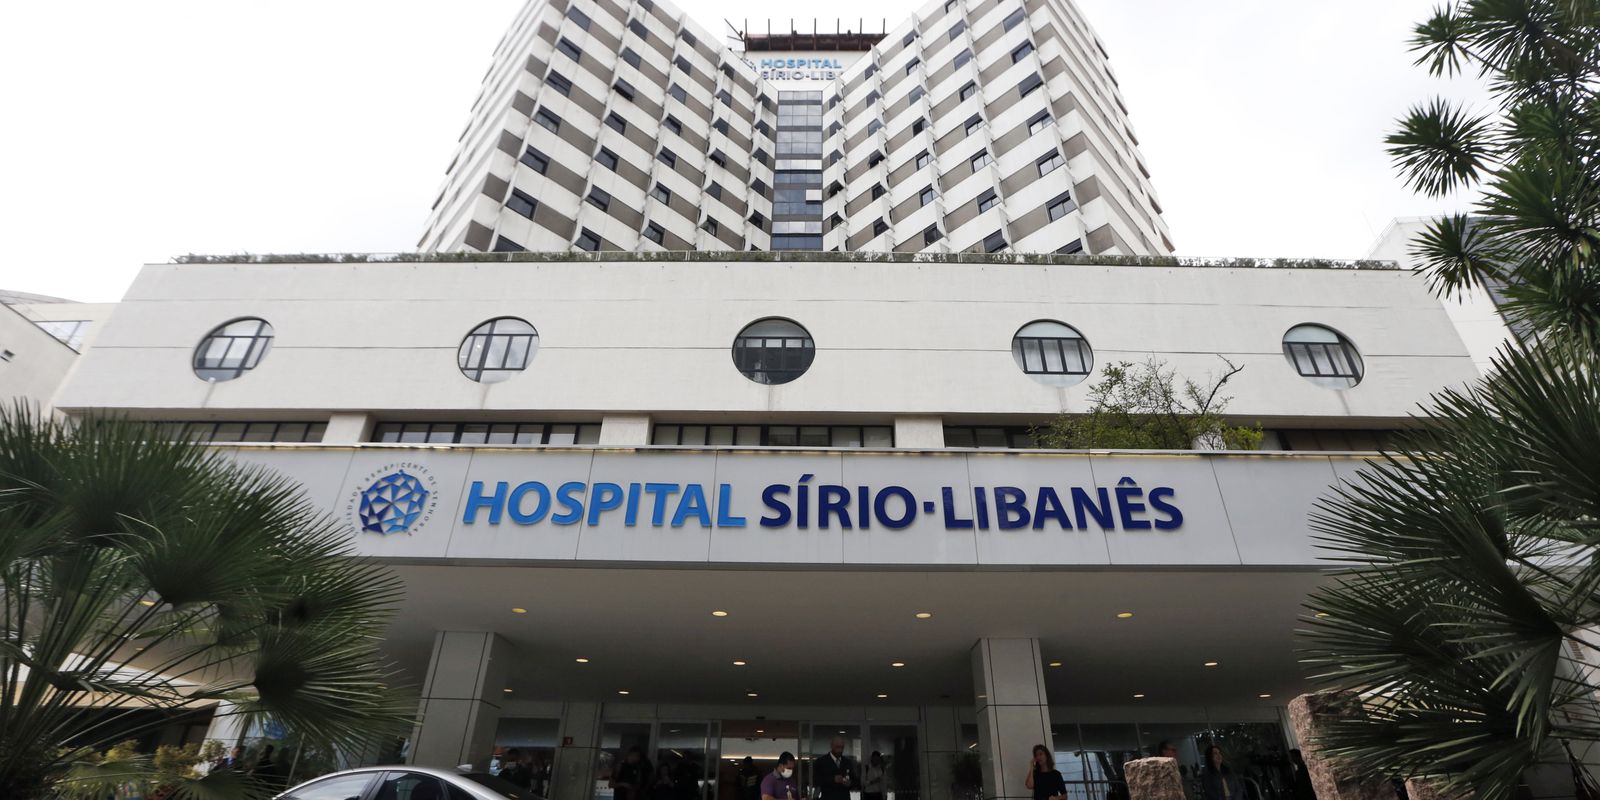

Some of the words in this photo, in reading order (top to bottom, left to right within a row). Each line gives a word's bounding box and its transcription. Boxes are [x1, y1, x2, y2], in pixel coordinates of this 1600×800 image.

[761, 58, 842, 69] HOSPITAL
[428, 475, 437, 486] DE
[407, 490, 438, 537] SENHORAS
[463, 481, 746, 527] HOSPITAL
